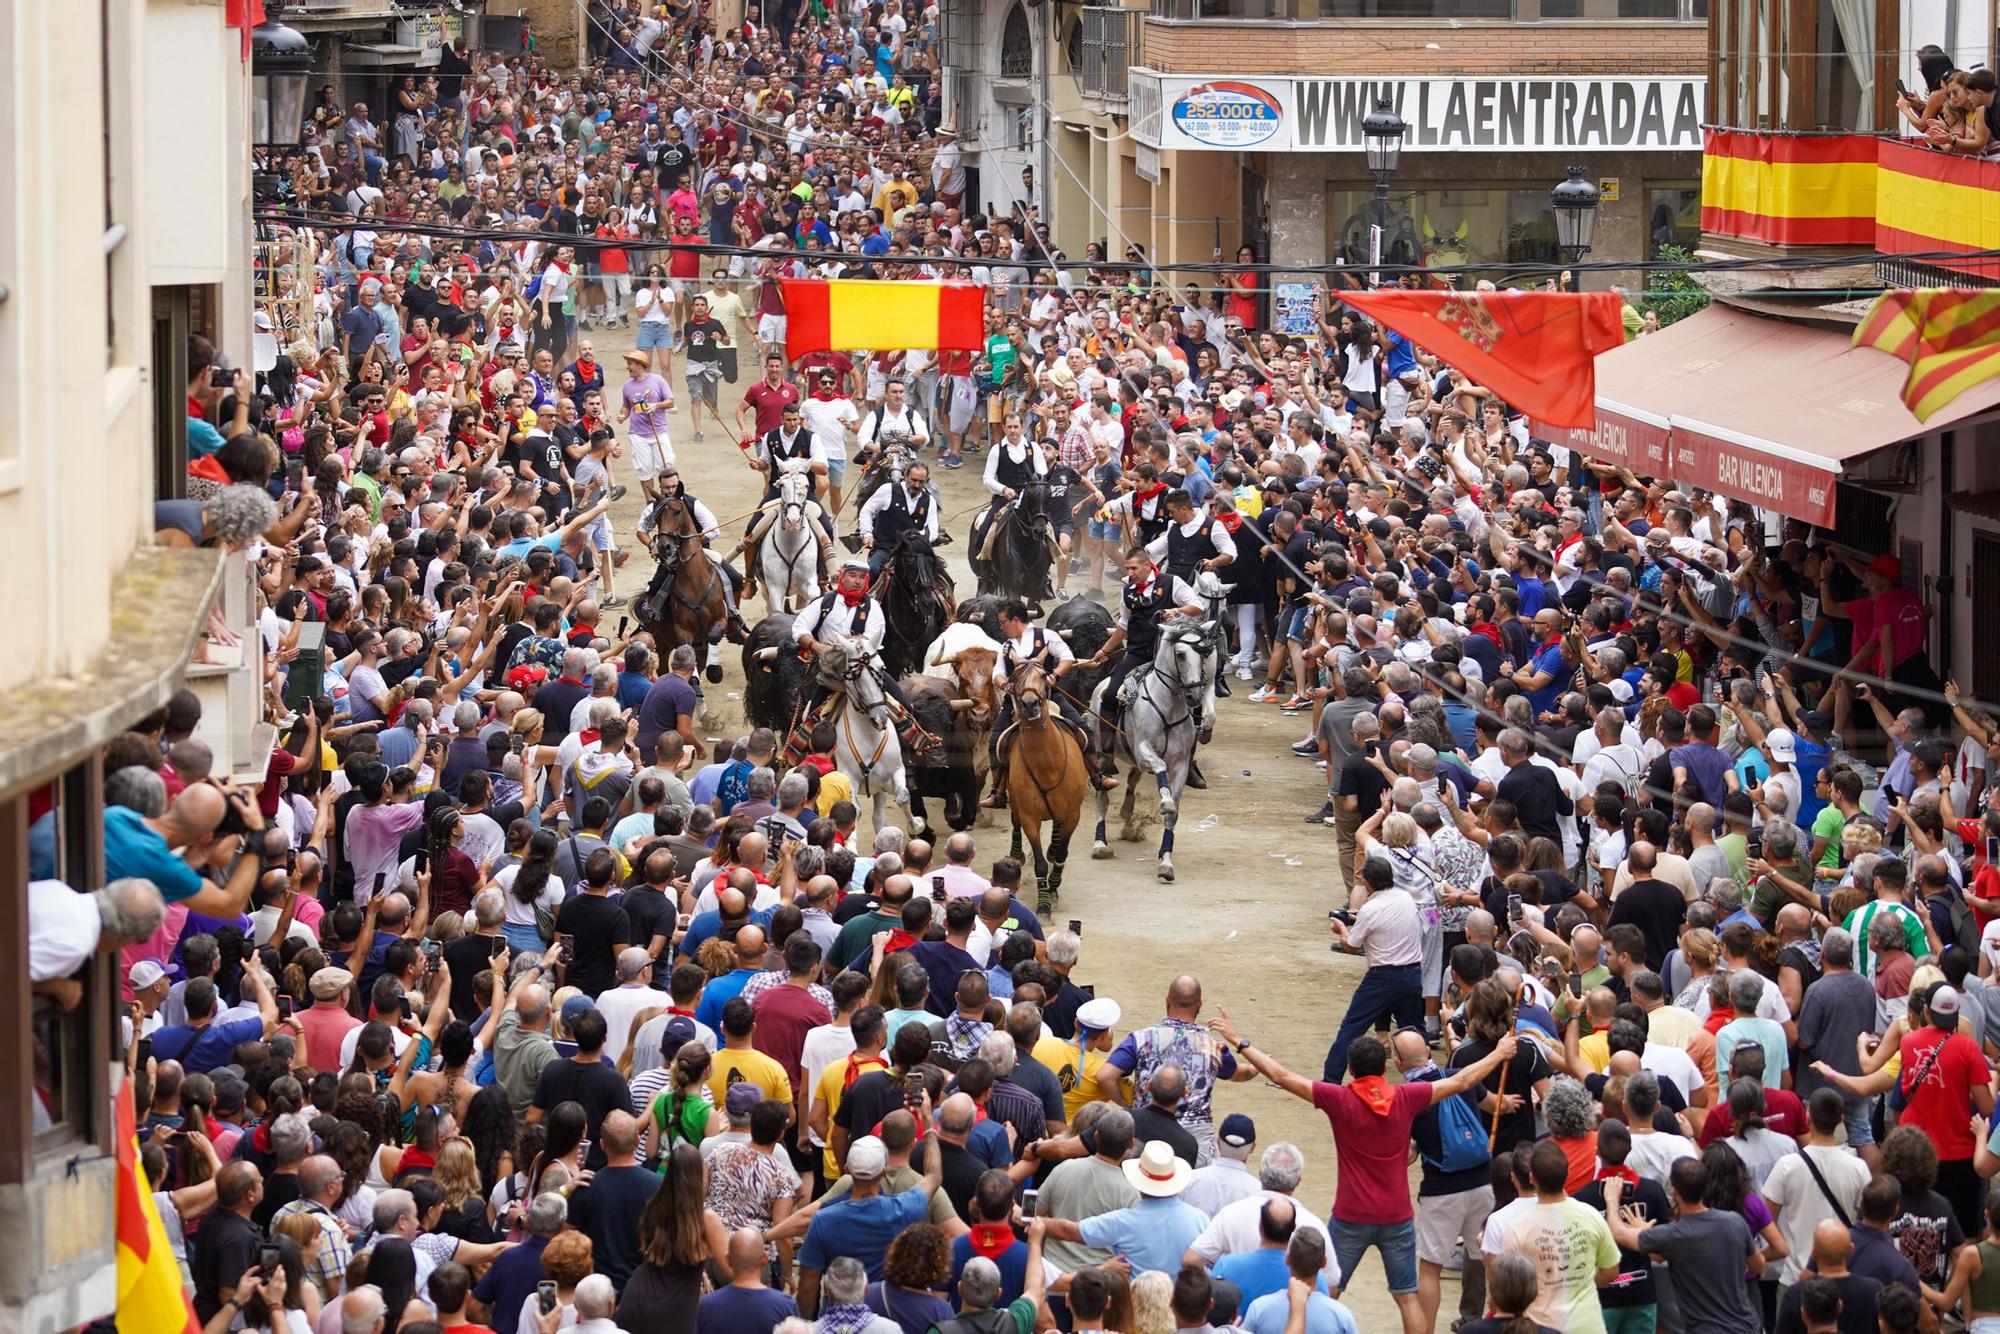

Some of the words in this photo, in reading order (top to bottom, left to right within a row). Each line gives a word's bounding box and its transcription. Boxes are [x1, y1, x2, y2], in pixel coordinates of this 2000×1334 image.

[1186, 103, 1252, 119] 252.000
[1255, 104, 1265, 119] €
[1296, 82, 1707, 145] WWW.LAENTRADAA
[1589, 418, 1628, 457] VALENCIA
[1718, 452, 1738, 487] BAR
[1739, 458, 1784, 501] VALENCIA
